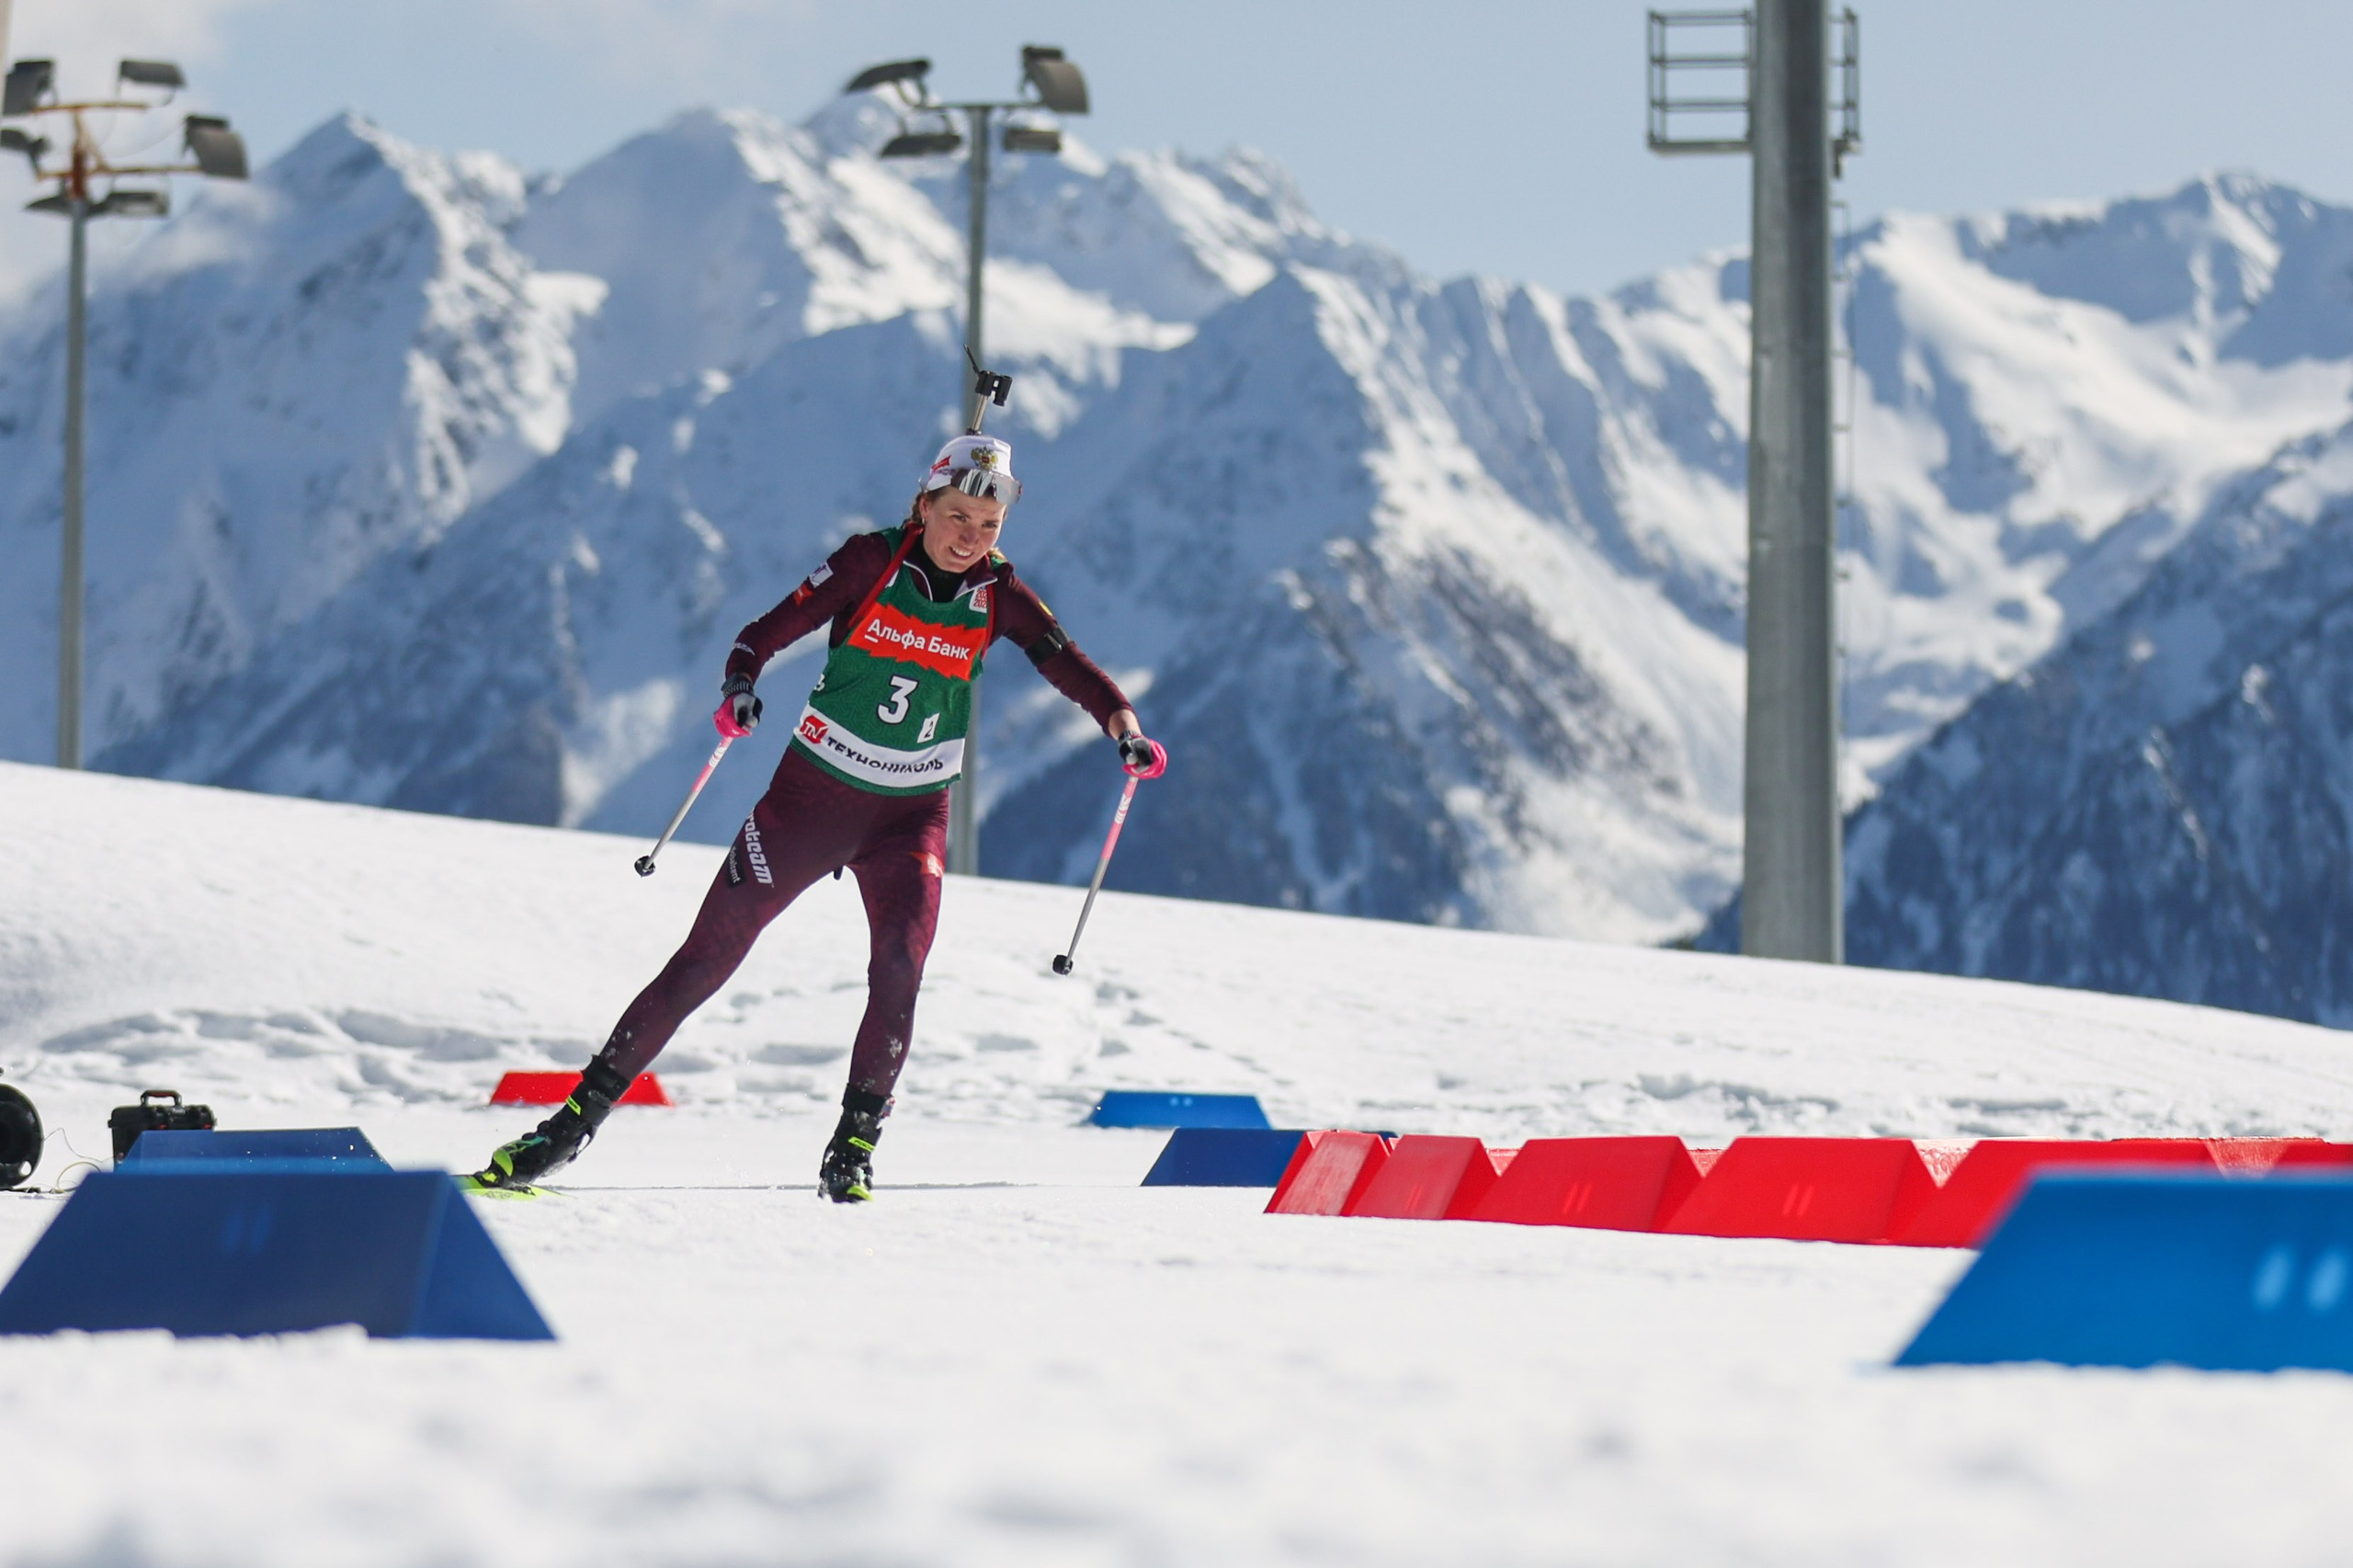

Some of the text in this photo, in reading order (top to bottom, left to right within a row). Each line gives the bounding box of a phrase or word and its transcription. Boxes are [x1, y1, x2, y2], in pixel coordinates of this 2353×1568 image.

[866, 618, 971, 660] Альфа Банк
[877, 675, 918, 724] 3
[925, 721, 934, 739] 2
[827, 736, 944, 773] ТЕХНОНИКОЛЬ
